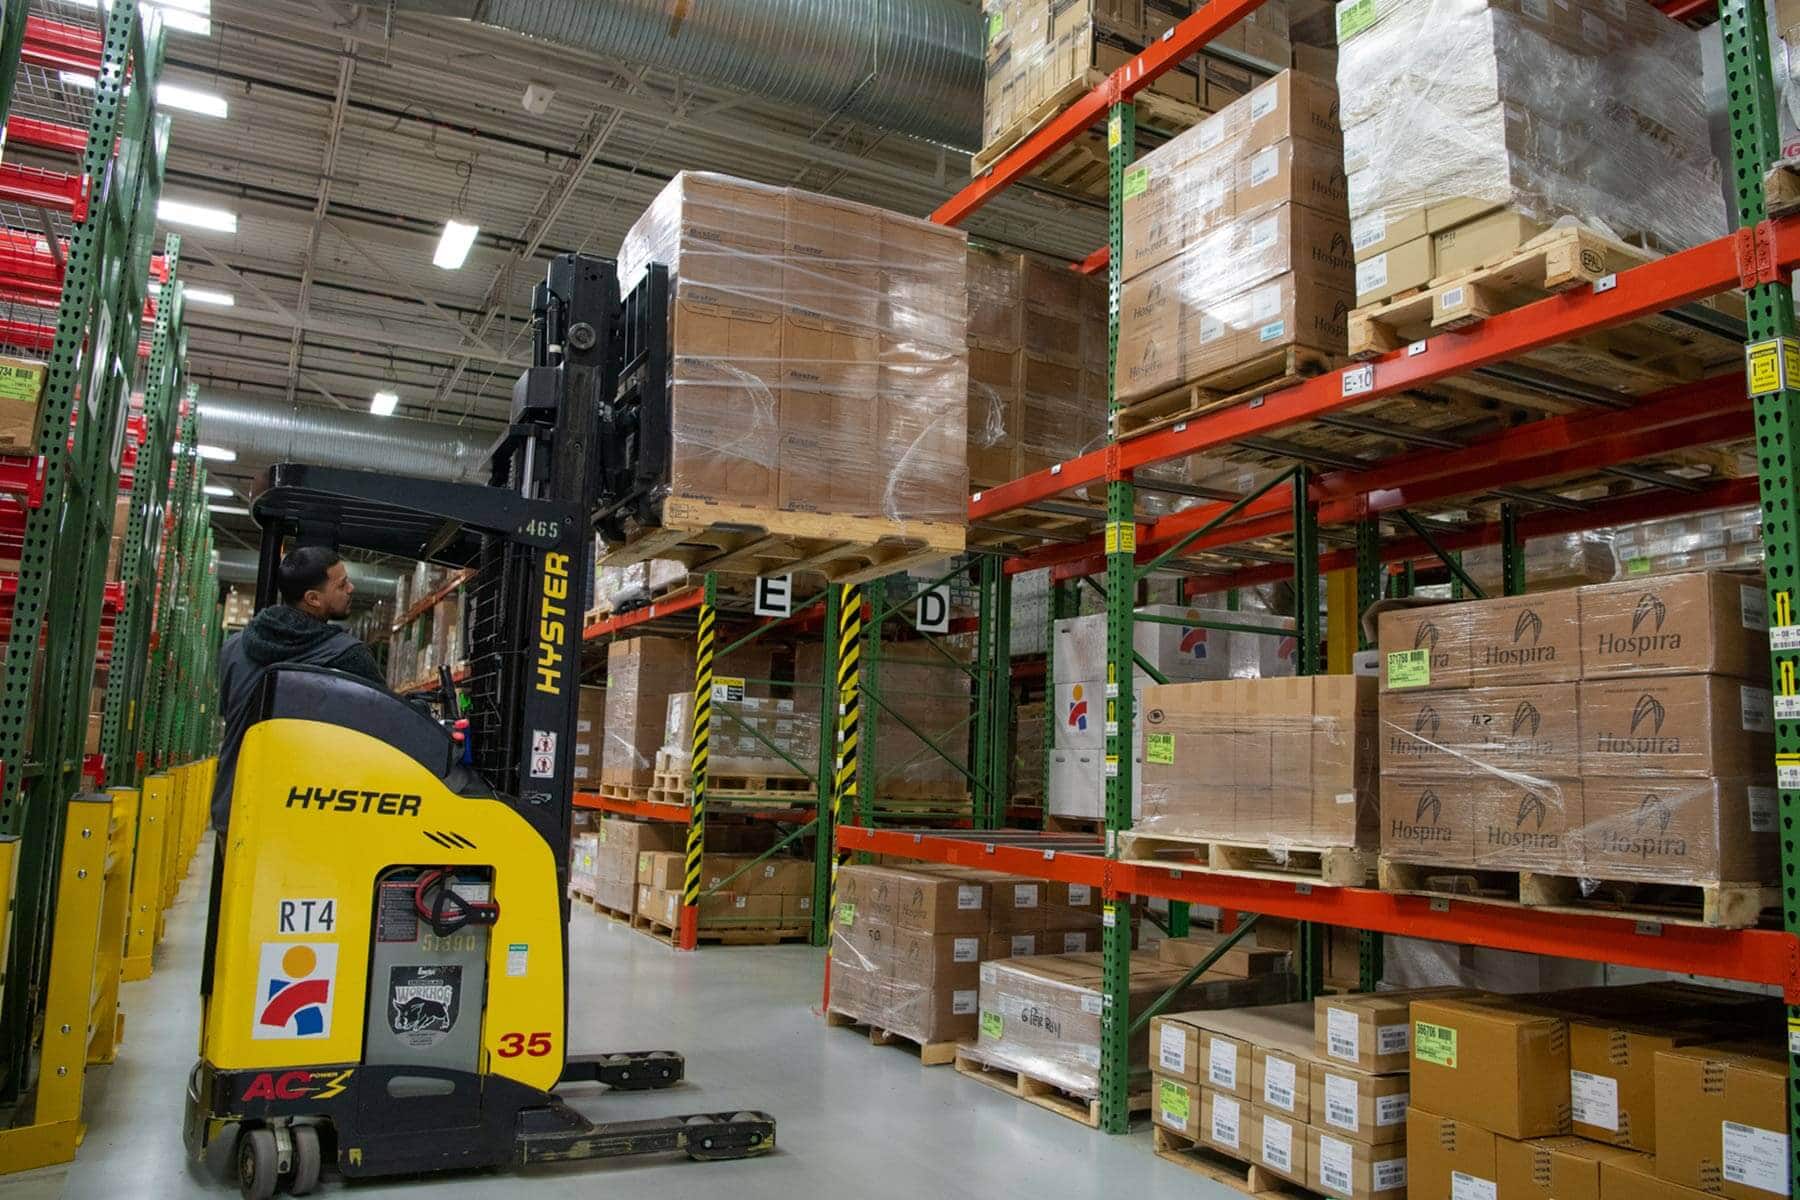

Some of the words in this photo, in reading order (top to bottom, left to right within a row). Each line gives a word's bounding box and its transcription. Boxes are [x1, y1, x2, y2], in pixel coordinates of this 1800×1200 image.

[1311, 108, 1340, 136] Hosp
[1311, 177, 1346, 202] Hospi
[1311, 246, 1350, 269] Hospir
[1343, 366, 1373, 393] E-10
[759, 576, 787, 612] E
[920, 591, 946, 626] D
[536, 552, 569, 695] HYSTER
[1485, 645, 1556, 670] Hospira
[1598, 633, 1681, 657] Hospira
[1597, 732, 1680, 758] Hospira
[285, 786, 422, 817] HYSTER
[1391, 820, 1452, 845] Hospira
[1487, 826, 1559, 852] Hospira
[1601, 829, 1687, 859] Hospira
[280, 900, 334, 932] RT4
[395, 985, 453, 1006] WORKHOG
[497, 1032, 552, 1058] 35
